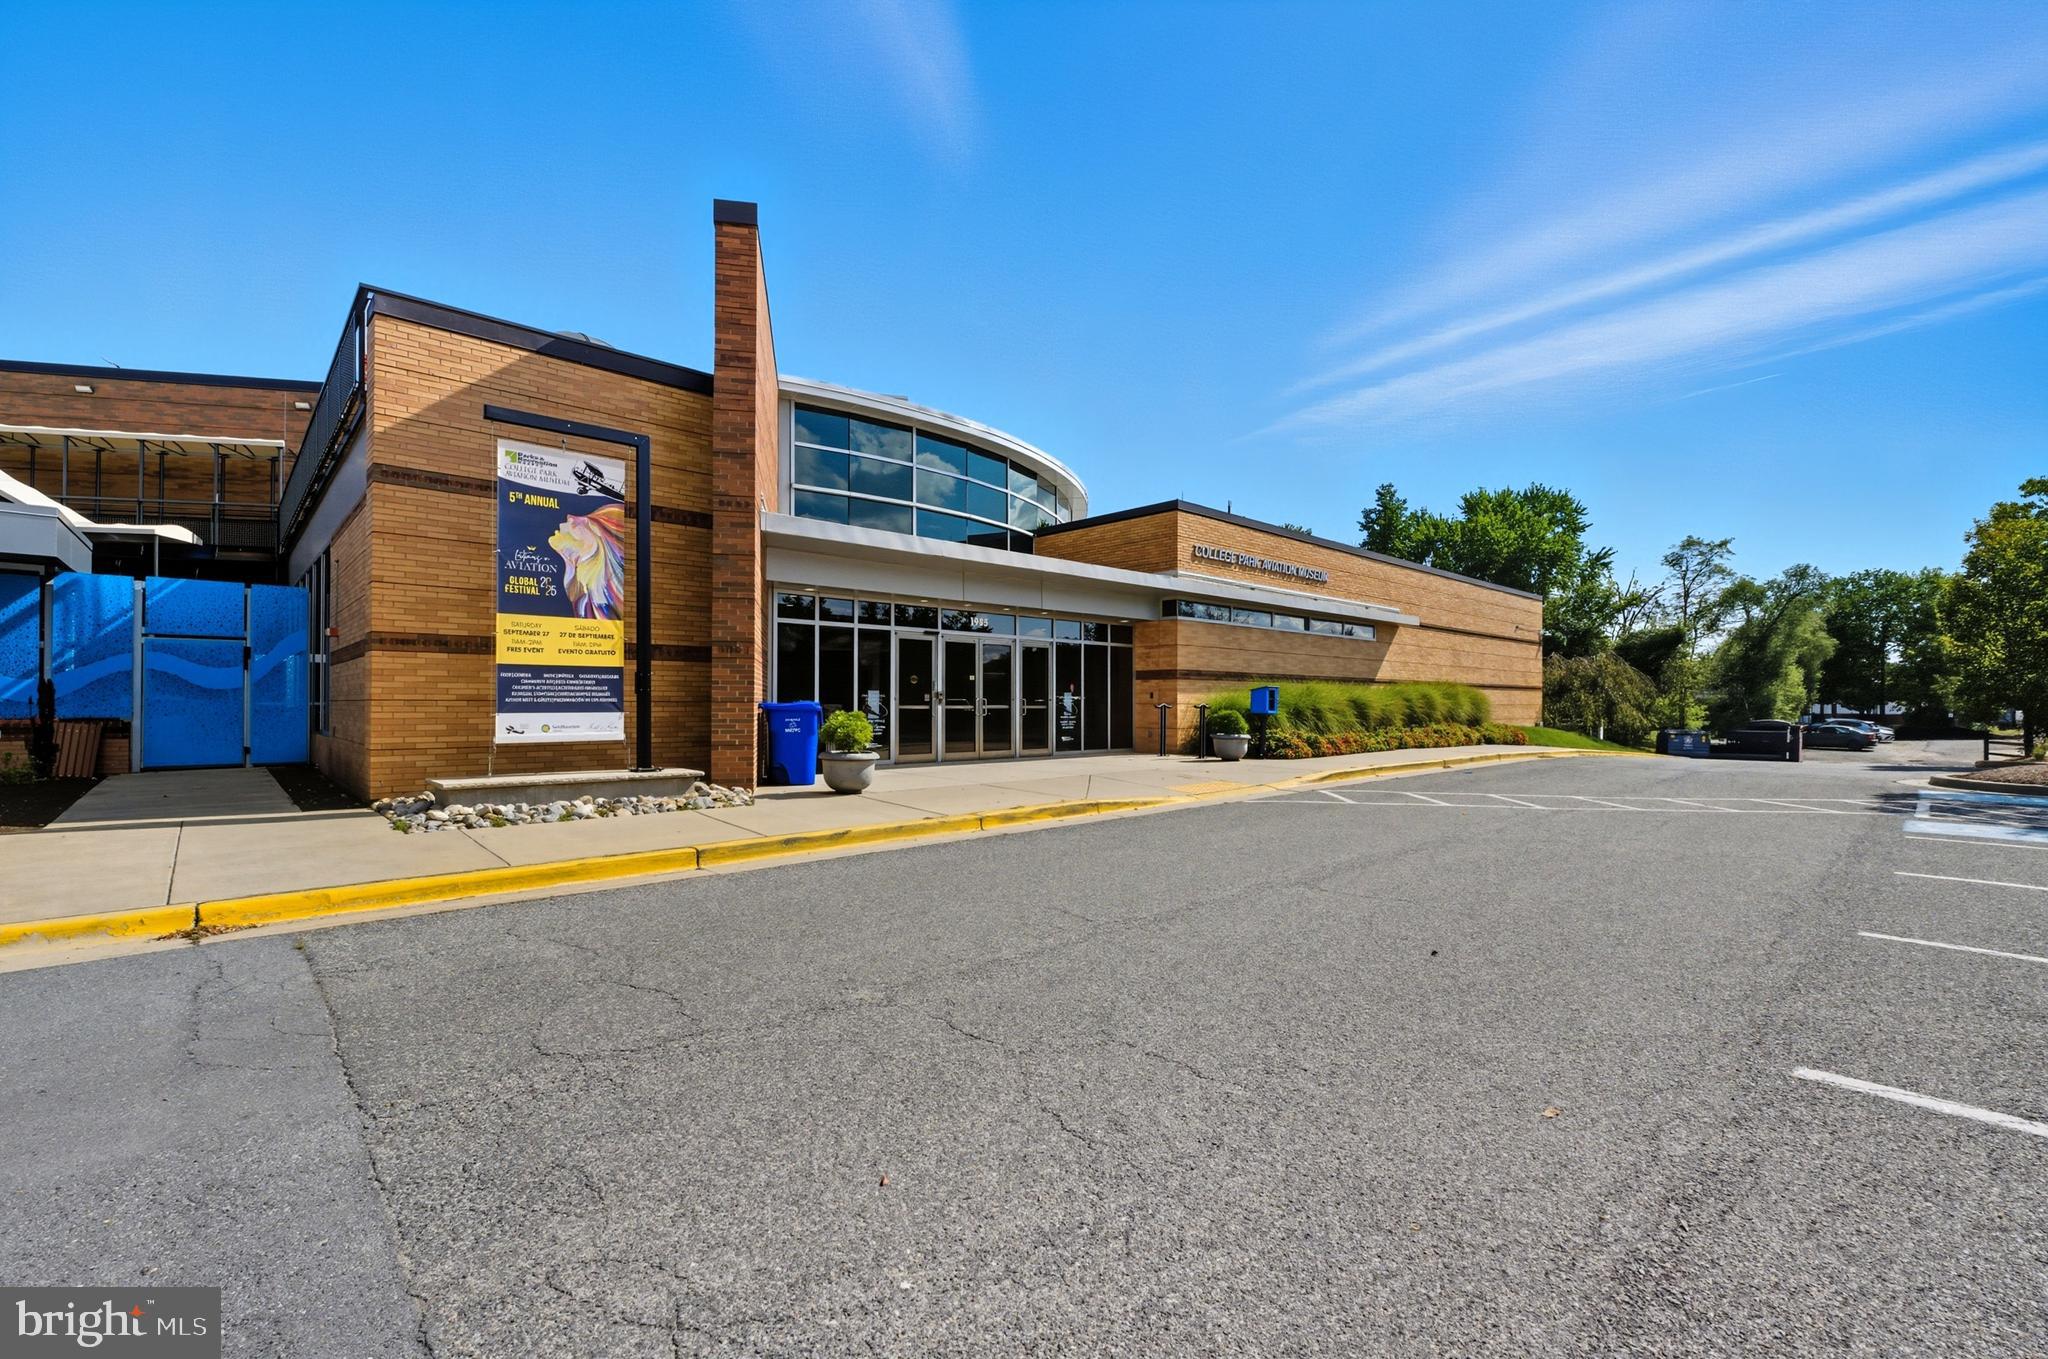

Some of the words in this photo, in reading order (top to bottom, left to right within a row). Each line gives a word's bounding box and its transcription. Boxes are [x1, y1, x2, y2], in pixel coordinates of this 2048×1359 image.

[504, 463, 537, 474] COLLEGE
[540, 469, 558, 477] PARK
[524, 494, 560, 509] ANNUAL
[504, 560, 558, 573] AVIATION
[1194, 543, 1237, 563] COLLEGE
[1237, 552, 1262, 568] PARK
[1262, 559, 1298, 576] AVIATION
[1298, 567, 1329, 583] MUSEUM
[509, 575, 539, 587] GLOBAL
[504, 583, 541, 596] FESTIVAL
[511, 621, 542, 629] SATURDAY
[970, 616, 989, 627] 1985
[503, 629, 541, 637] SEPTEMBER
